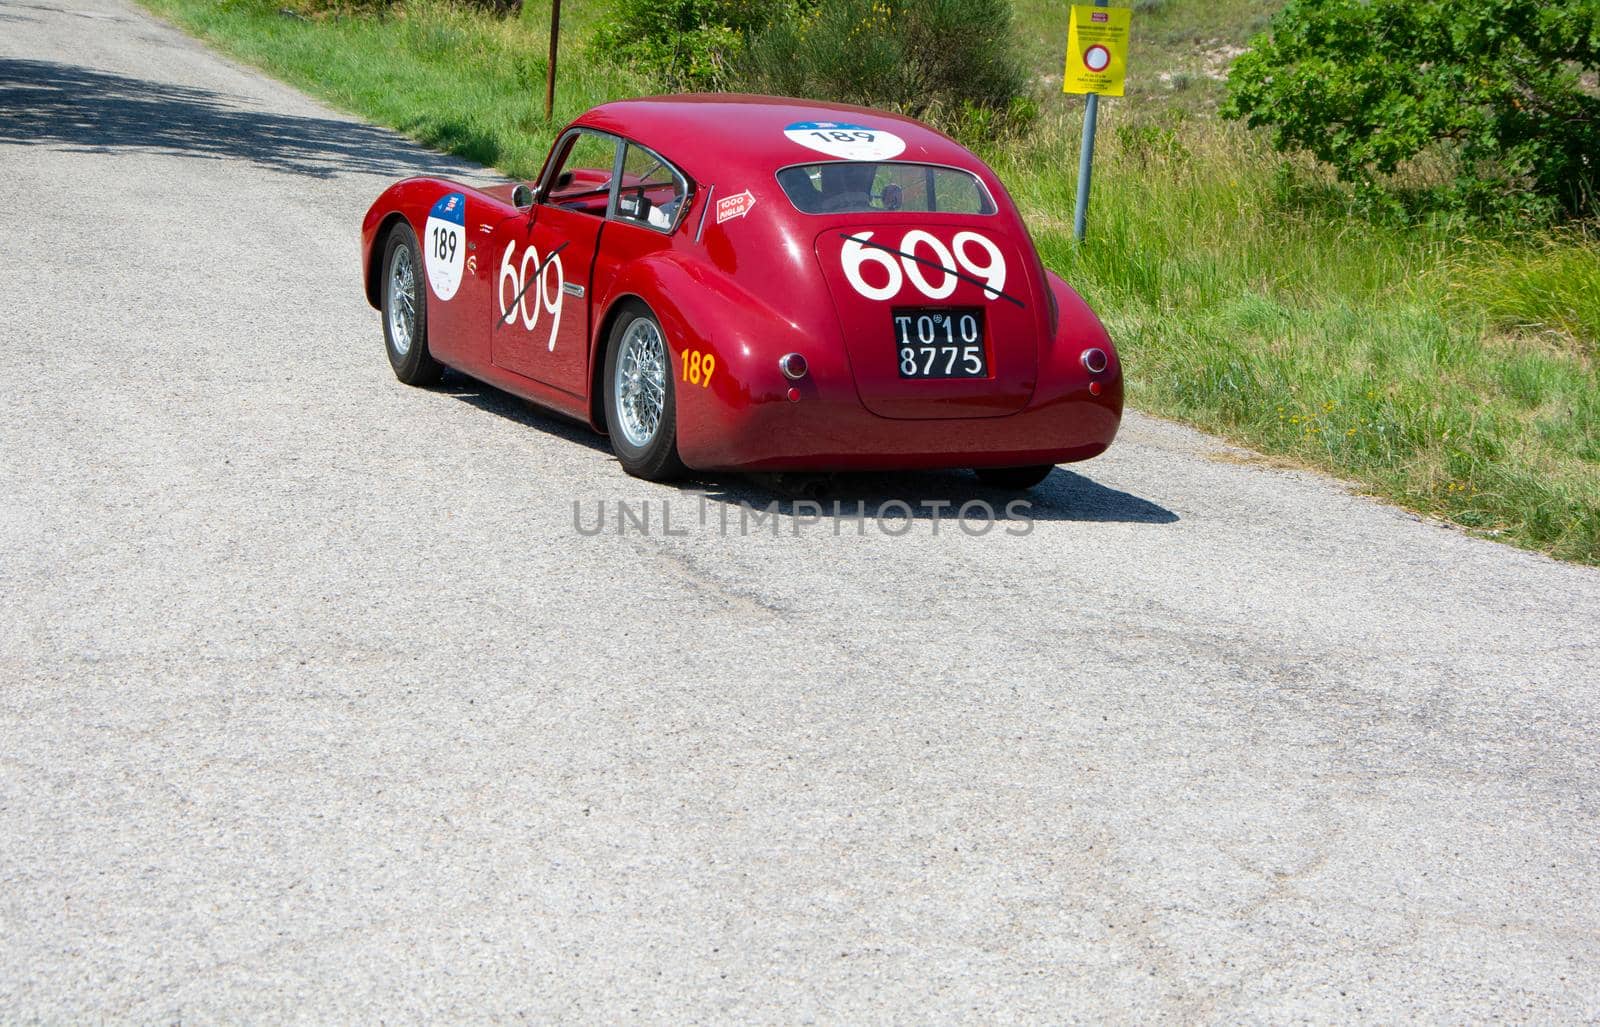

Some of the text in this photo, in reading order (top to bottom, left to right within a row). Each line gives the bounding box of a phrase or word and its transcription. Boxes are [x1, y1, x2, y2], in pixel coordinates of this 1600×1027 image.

[810, 131, 875, 143] 189
[721, 197, 744, 209] 1000
[433, 226, 457, 263] 189
[840, 229, 1007, 301] 609
[499, 239, 564, 352] 609
[681, 348, 716, 388] 189
[900, 346, 982, 376] 8775
